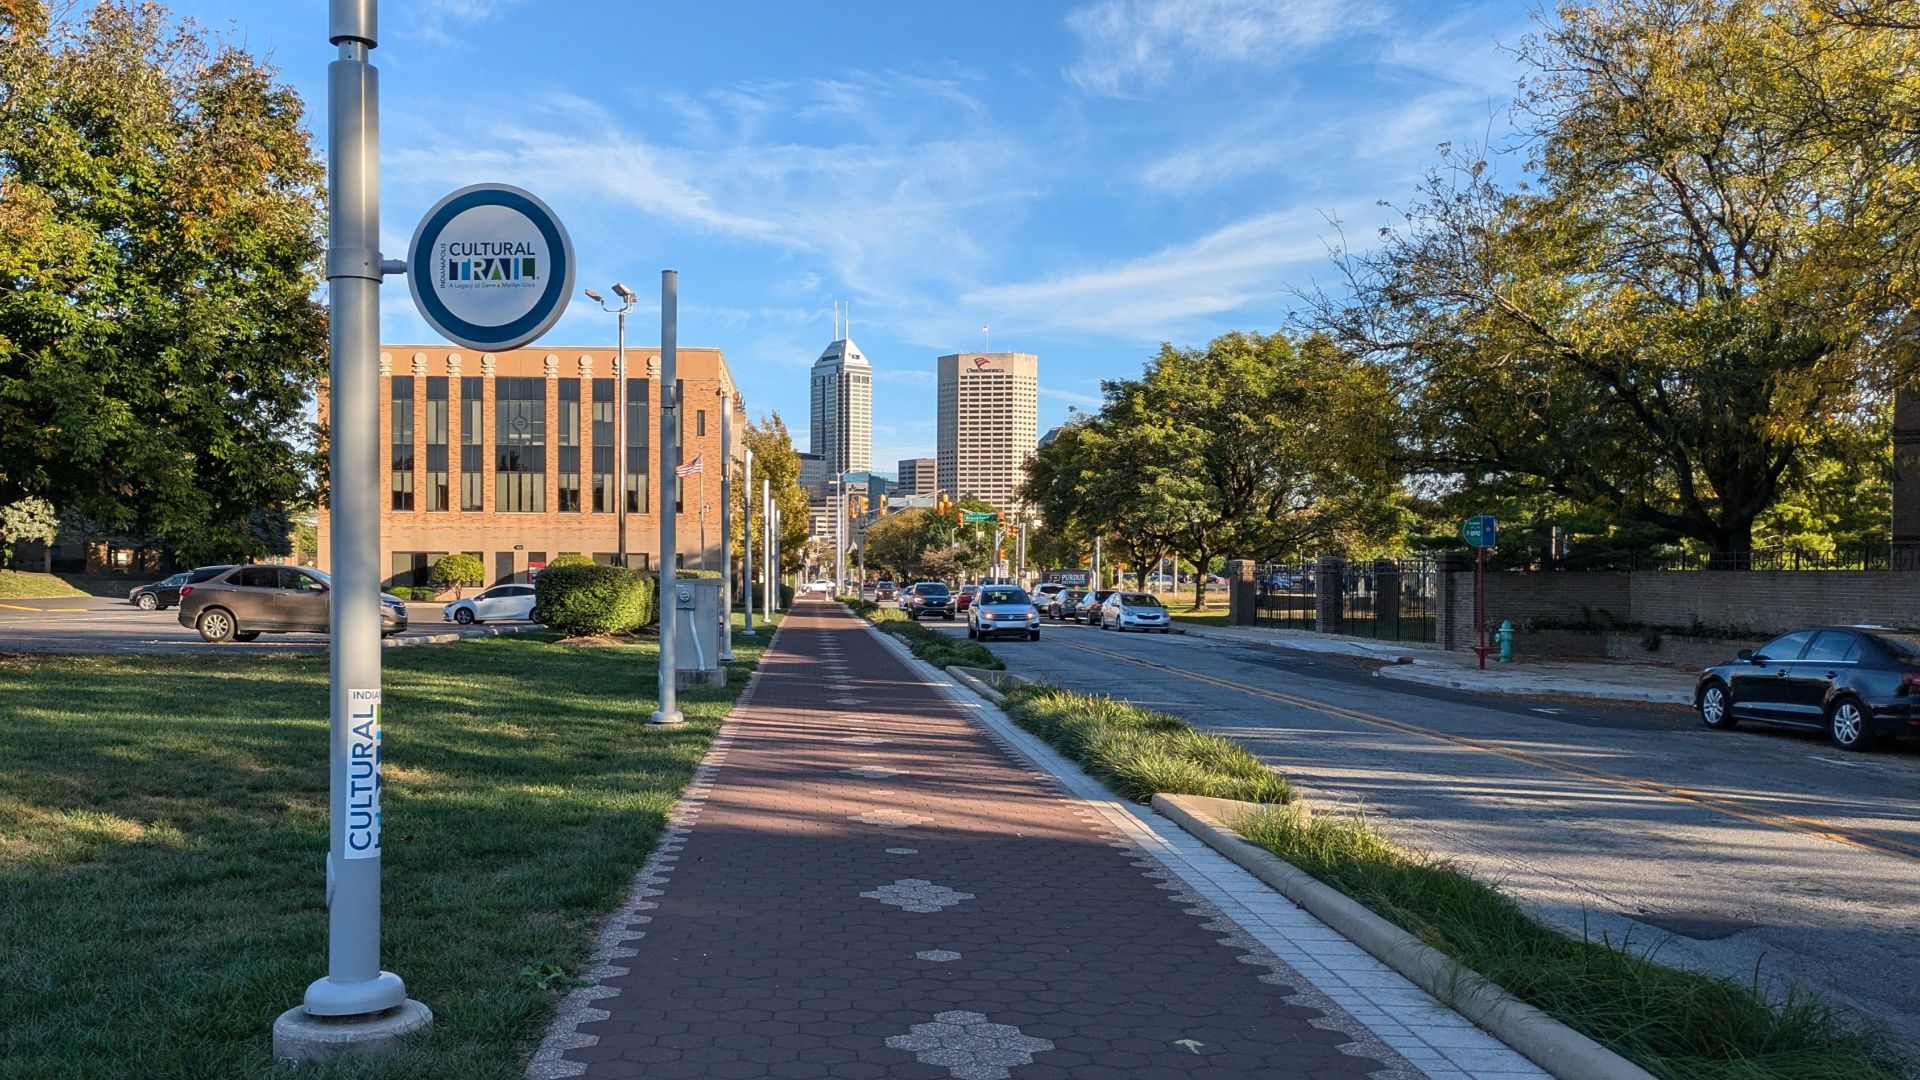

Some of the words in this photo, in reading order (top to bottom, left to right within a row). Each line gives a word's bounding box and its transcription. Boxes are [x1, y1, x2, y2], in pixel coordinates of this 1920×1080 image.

[449, 242, 535, 256] CULTURAL
[449, 258, 536, 280] TRAIL
[349, 704, 374, 851] CULTURAL
